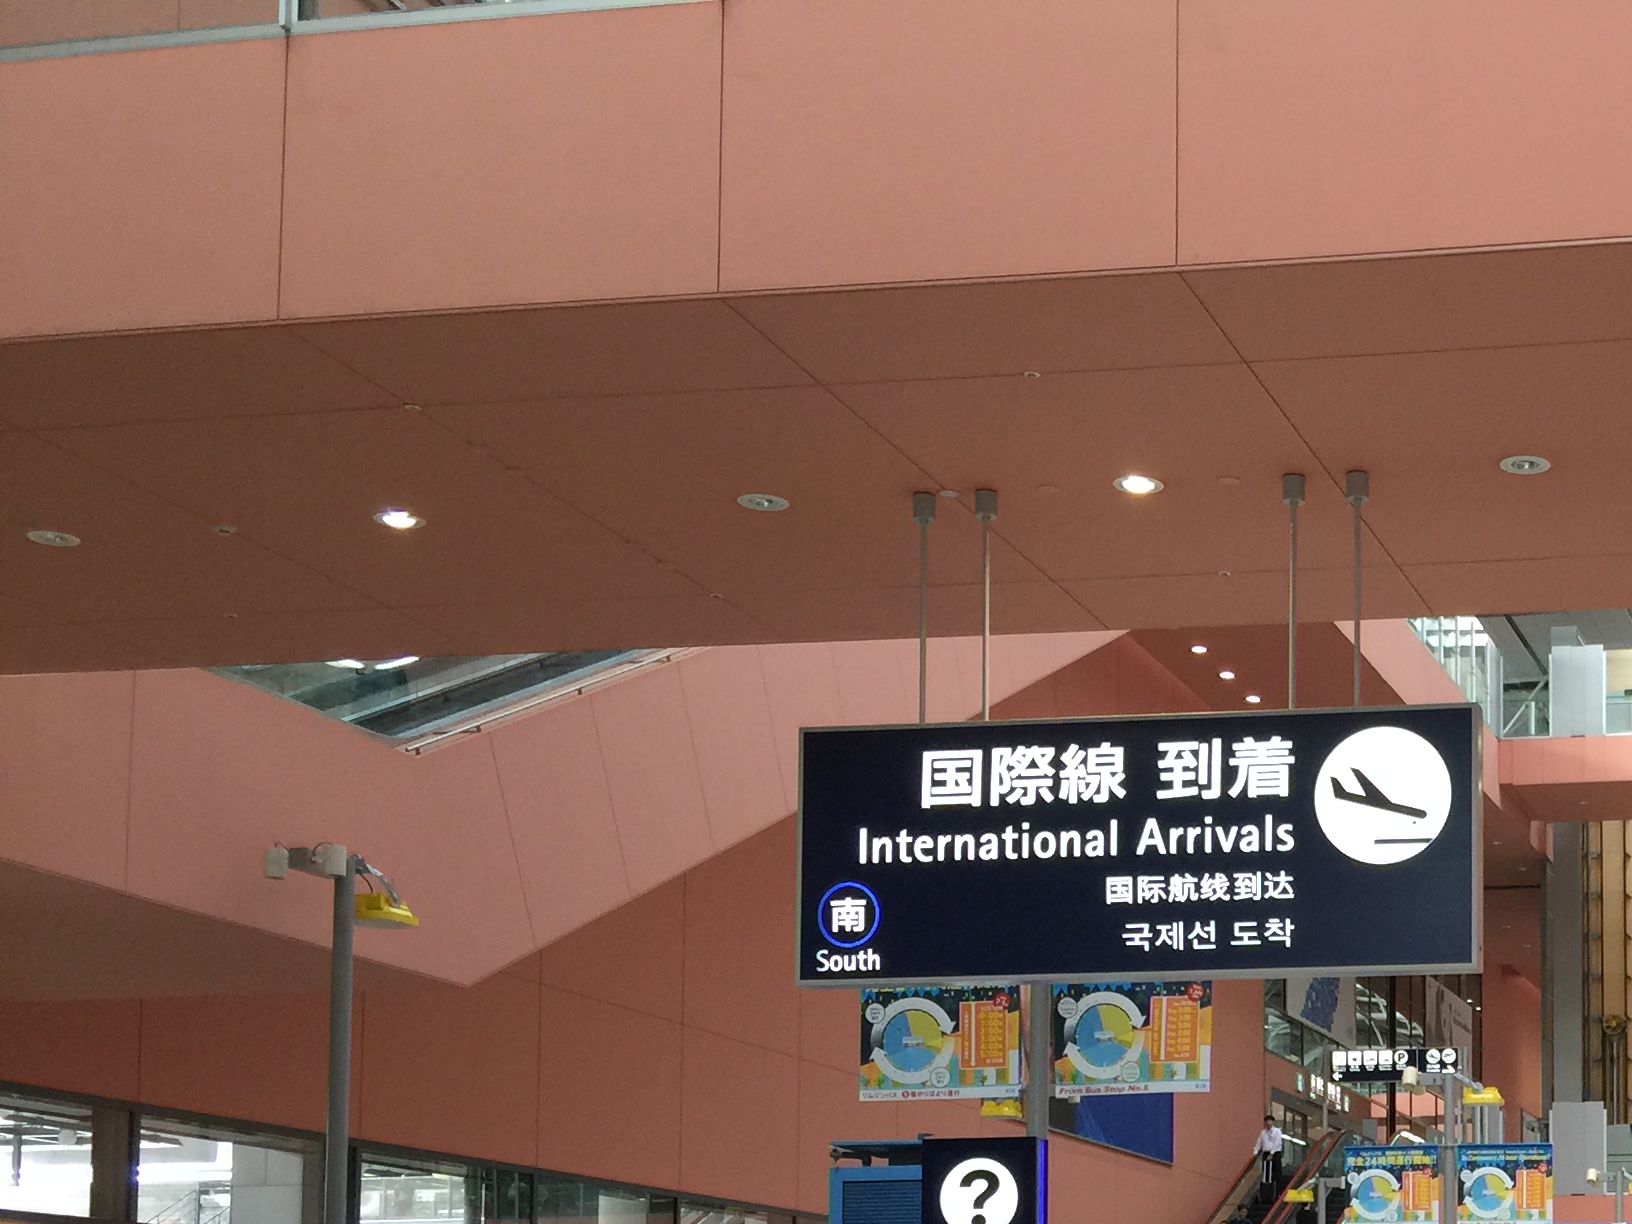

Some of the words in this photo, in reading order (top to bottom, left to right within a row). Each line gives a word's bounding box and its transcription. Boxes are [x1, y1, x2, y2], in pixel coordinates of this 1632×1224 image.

[920, 743, 1125, 809] 国際線
[1155, 736, 1296, 802] 到着
[857, 819, 1118, 865] International
[1136, 815, 1295, 856] Arrivals
[1105, 871, 1296, 905] 国际航线到达
[829, 898, 867, 932] 南
[1122, 922, 1217, 951] 국제선
[1230, 918, 1296, 948] 도착
[815, 948, 881, 972] South
